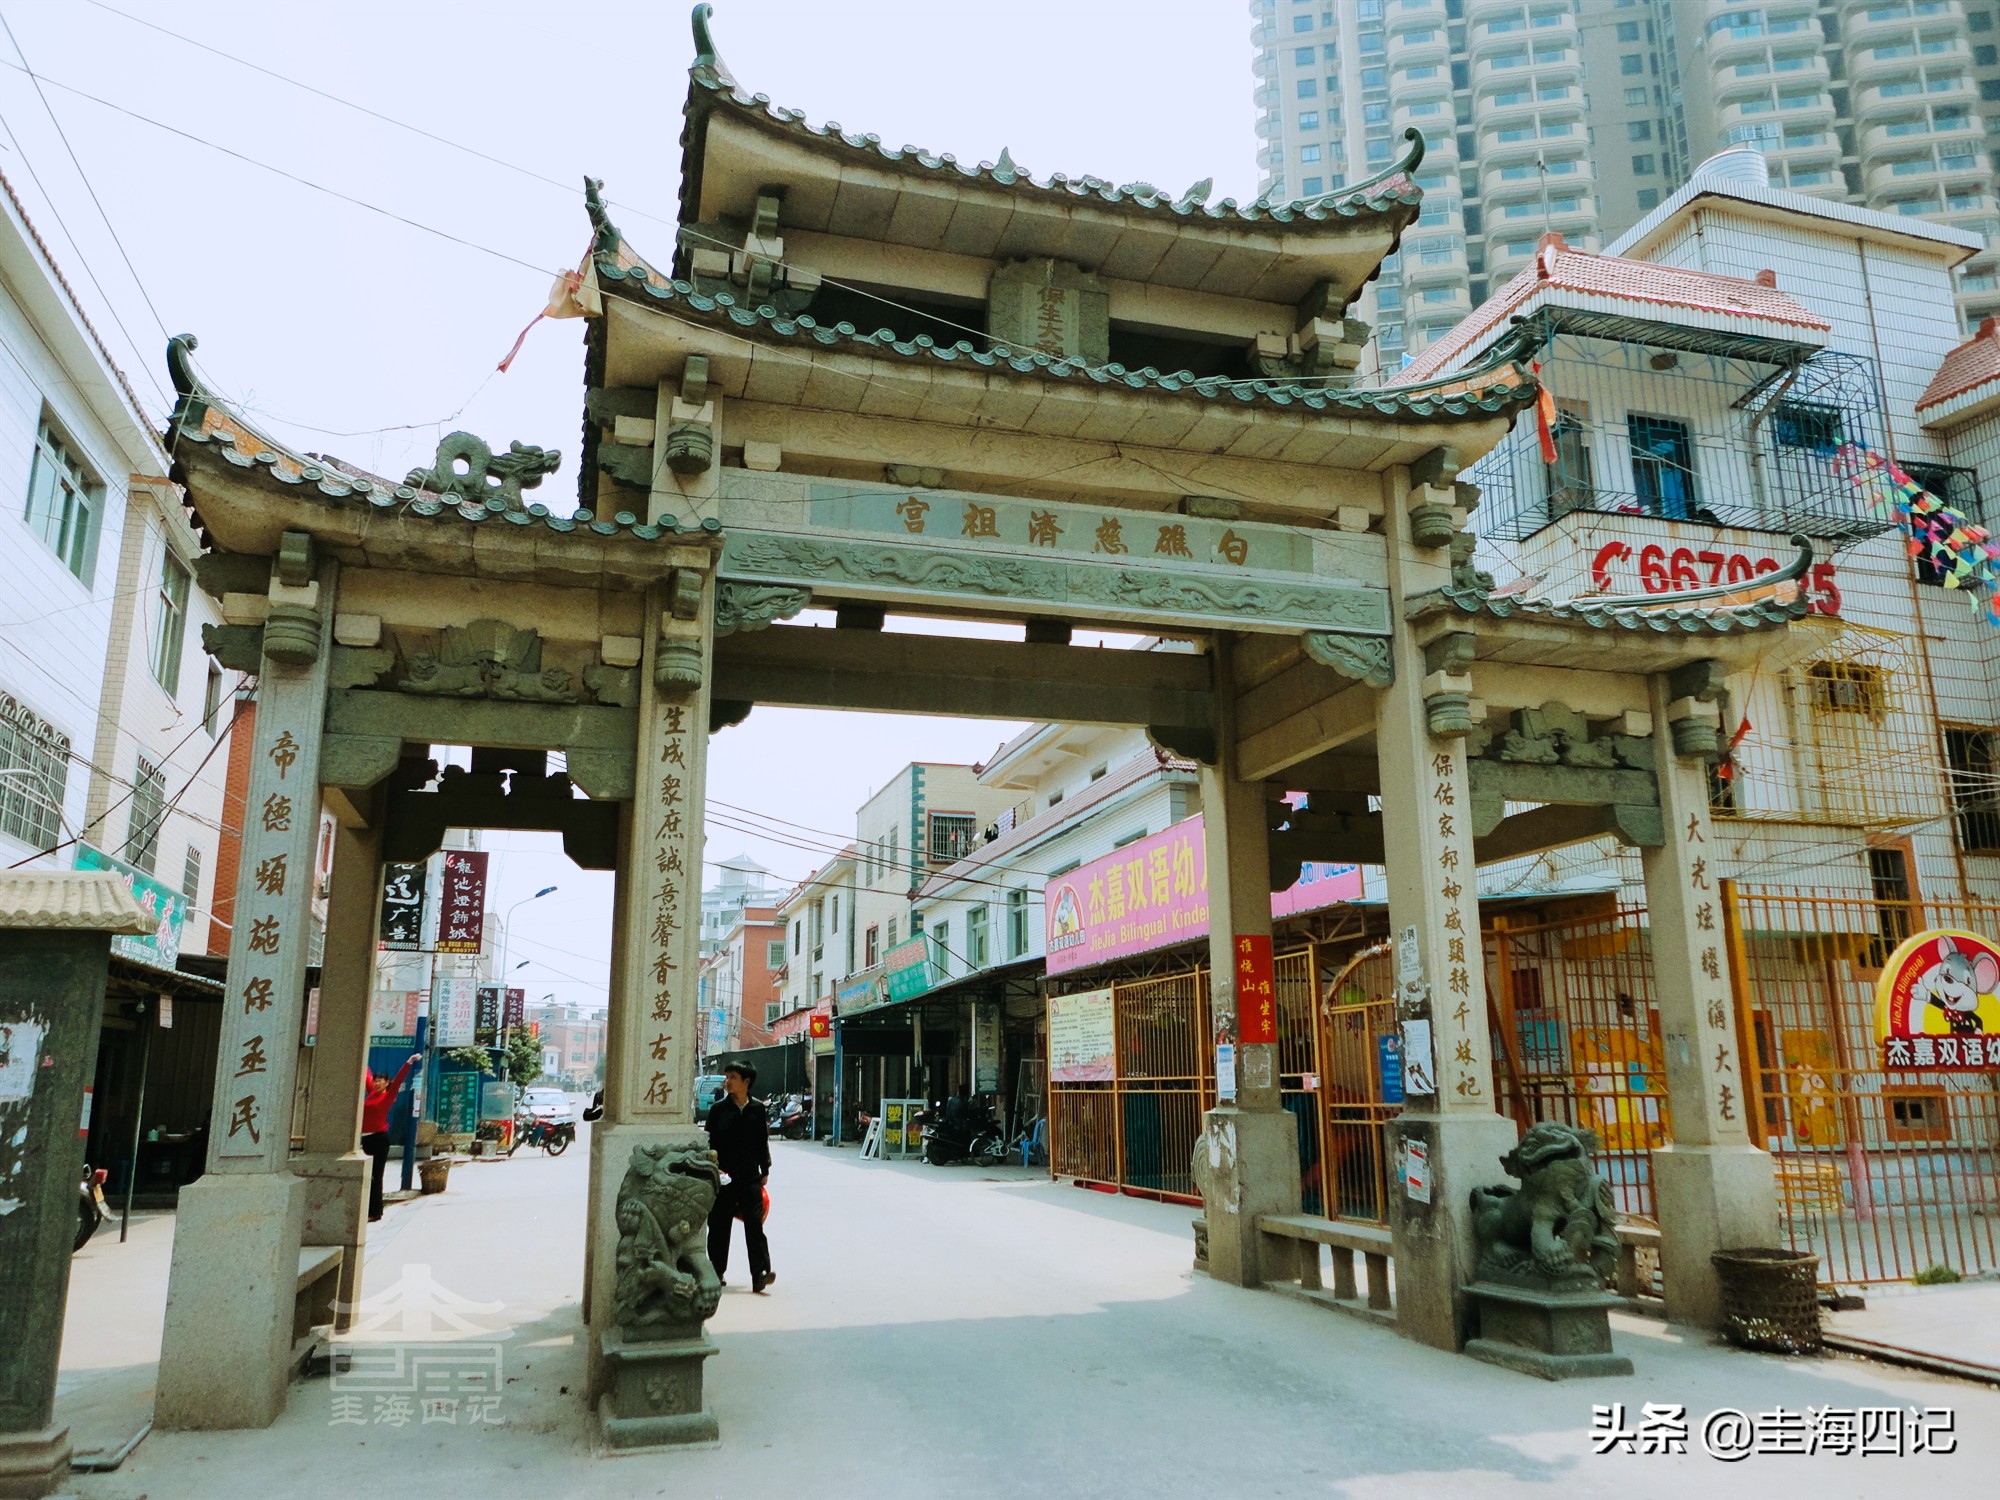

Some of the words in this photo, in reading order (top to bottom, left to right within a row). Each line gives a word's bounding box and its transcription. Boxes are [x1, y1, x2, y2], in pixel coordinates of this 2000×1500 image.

[1640, 543, 1843, 616] 66705
[1088, 828, 1209, 928] 杰嘉双语幼
[1090, 929, 1117, 952] JieJia
[1120, 914, 1168, 942] Bilingual
[1240, 938, 1256, 993] 谁烧山
[1896, 955, 1926, 994] Bilingual
[1257, 980, 1273, 1037] 谁坐牢
[1892, 995, 1904, 1028] JieJia
